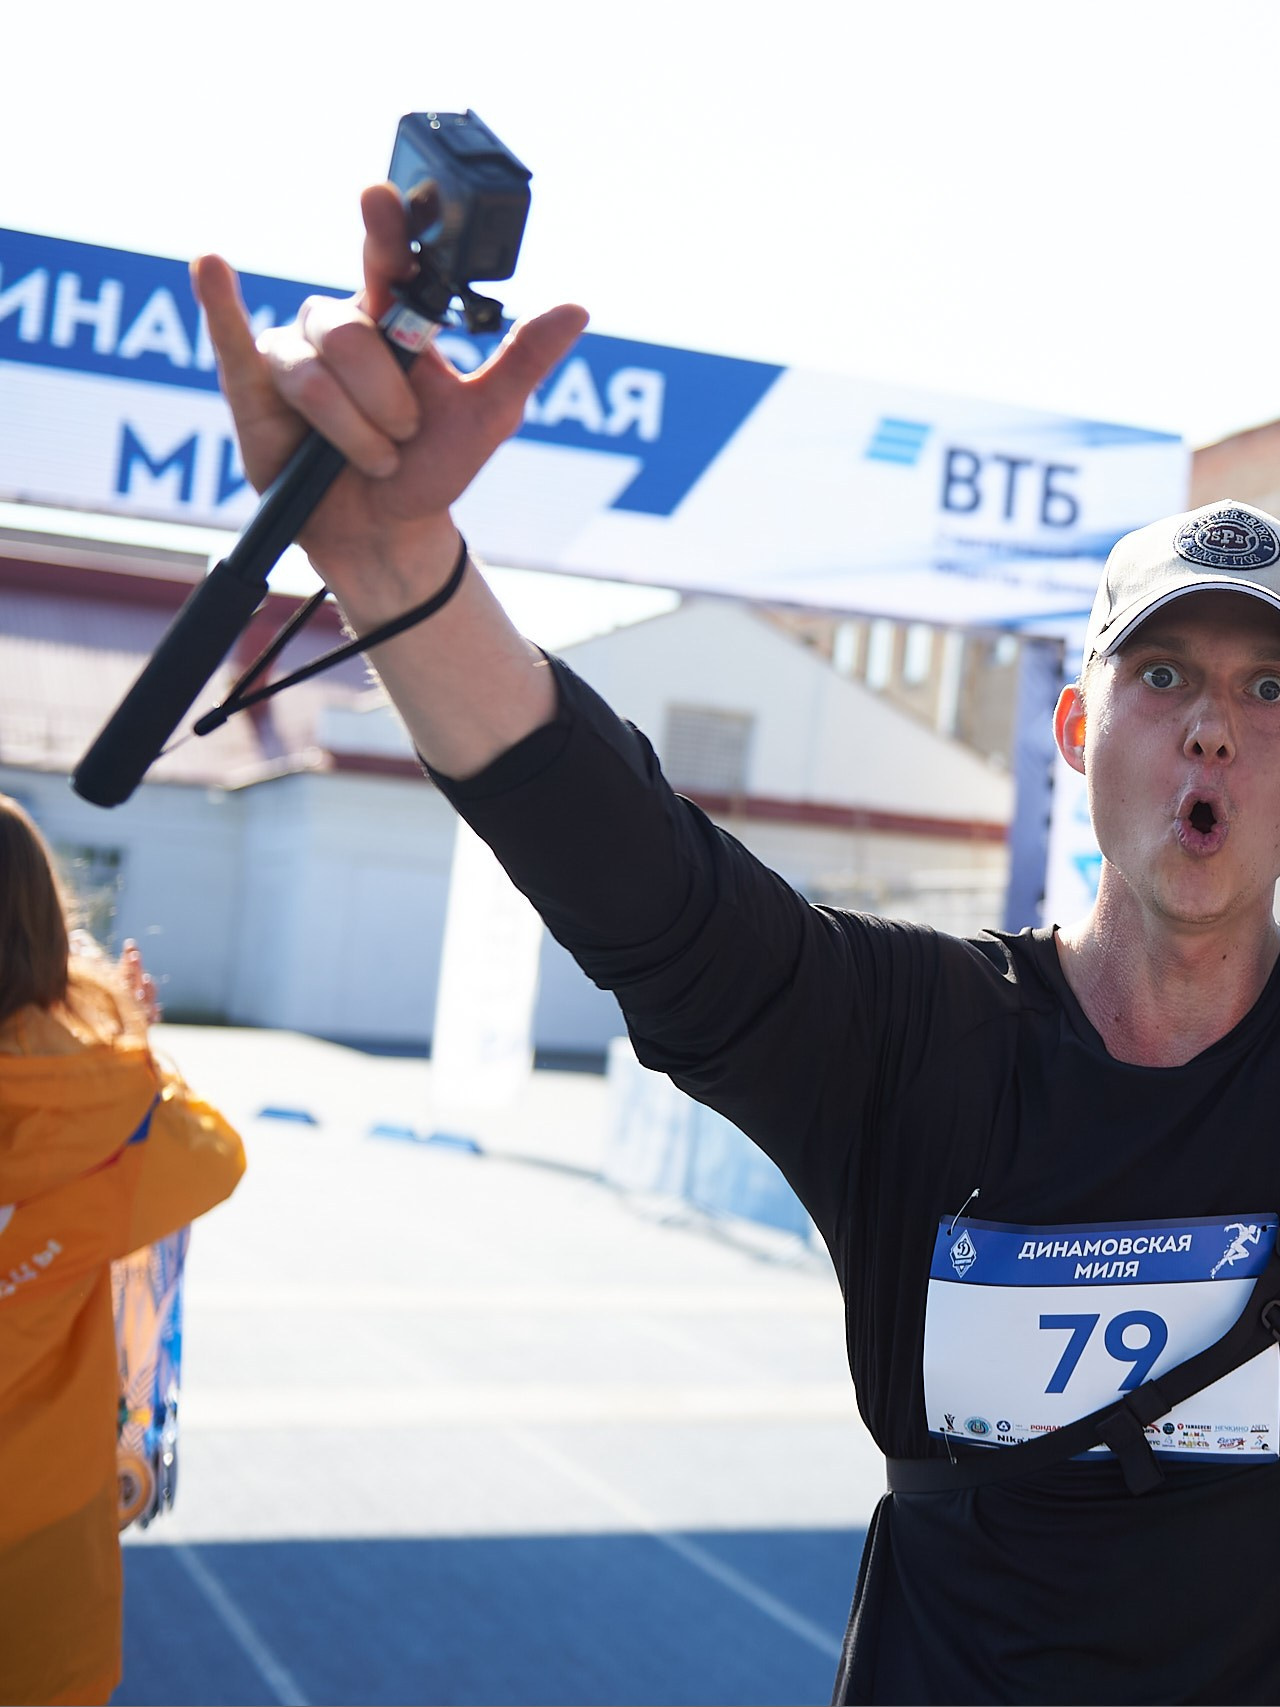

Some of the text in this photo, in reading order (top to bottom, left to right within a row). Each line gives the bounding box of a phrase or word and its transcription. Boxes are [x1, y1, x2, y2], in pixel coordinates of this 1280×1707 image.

[941, 445, 1080, 529] ВТБ
[1189, 545, 1261, 566] SINCE 1703
[1018, 1234, 1192, 1260] ДИНАМОВСКАЯ
[1073, 1260, 1139, 1280] МИЛЯ
[1038, 1309, 1169, 1395] 79
